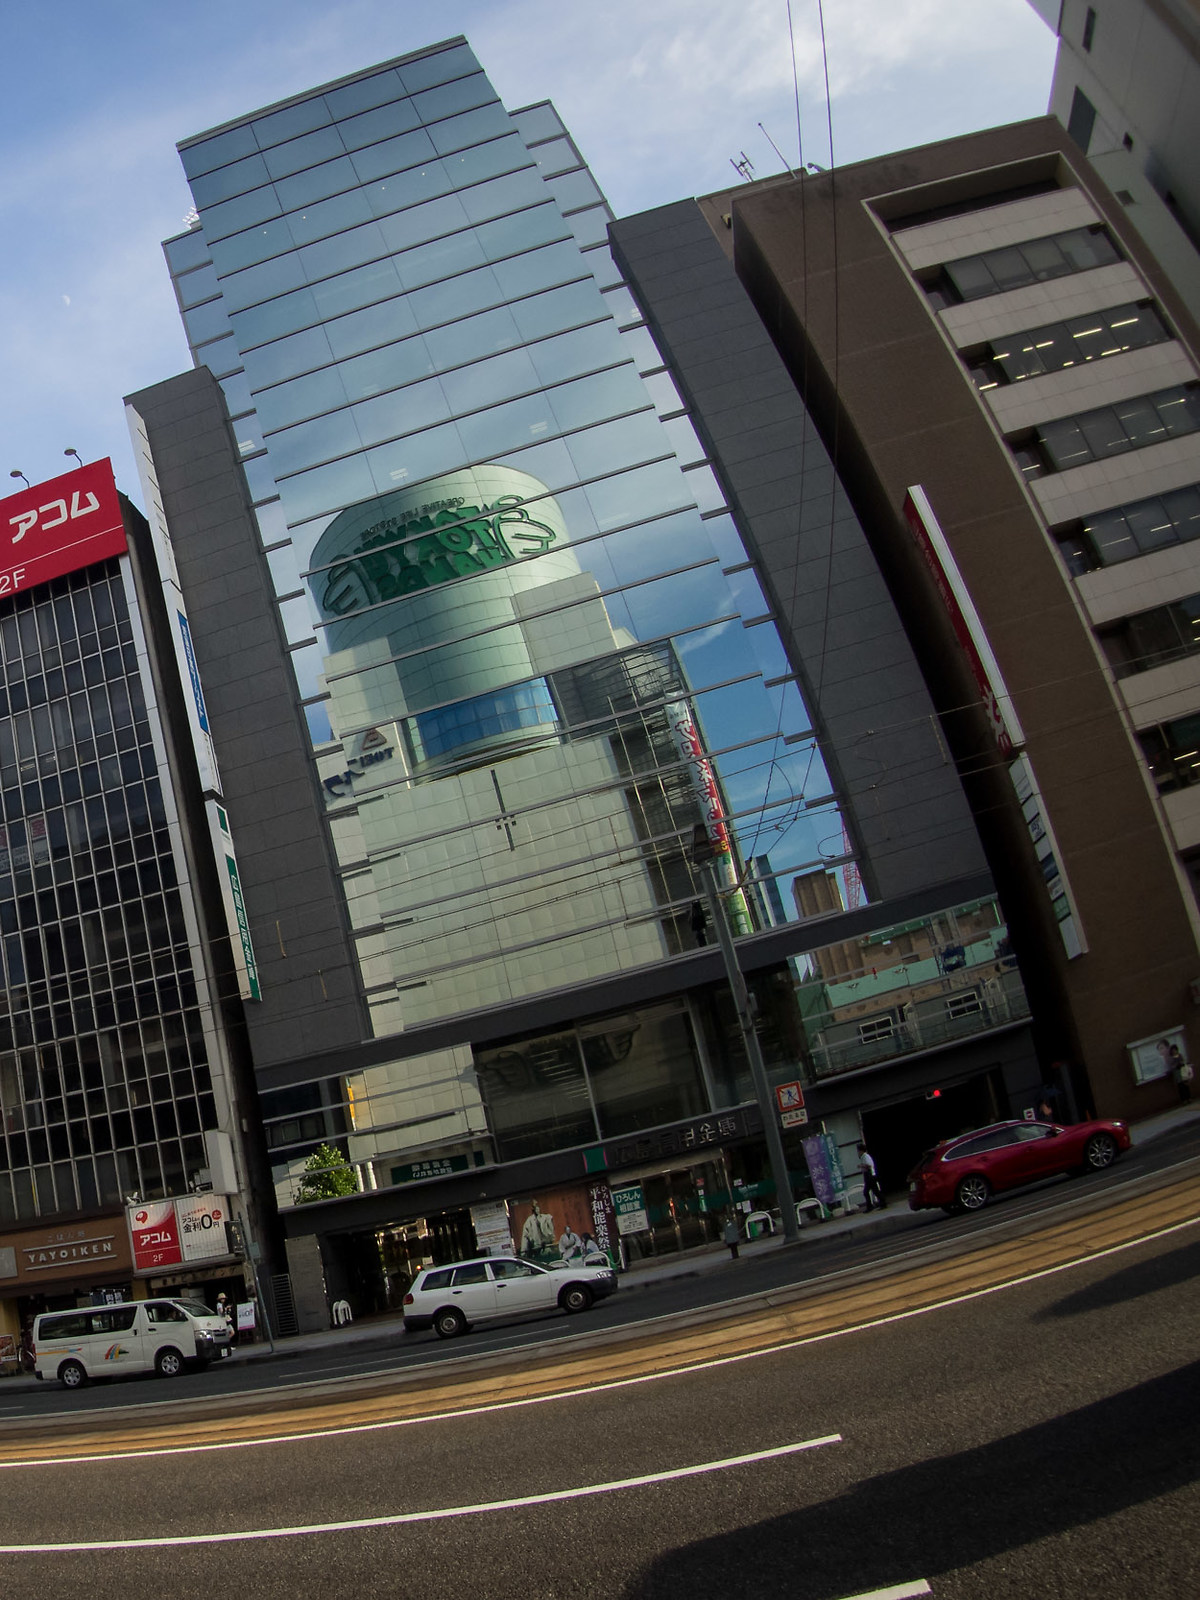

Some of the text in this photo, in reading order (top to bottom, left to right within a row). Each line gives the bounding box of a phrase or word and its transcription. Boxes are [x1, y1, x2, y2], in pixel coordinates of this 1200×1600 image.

[8, 490, 101, 544] アコム
[616, 1191, 641, 1203] ひろしん
[590, 1186, 611, 1250] 平和能楽祭
[139, 1231, 172, 1246] アコム
[28, 1242, 113, 1264] YAYOIKEN
[152, 1253, 163, 1263] 2F
